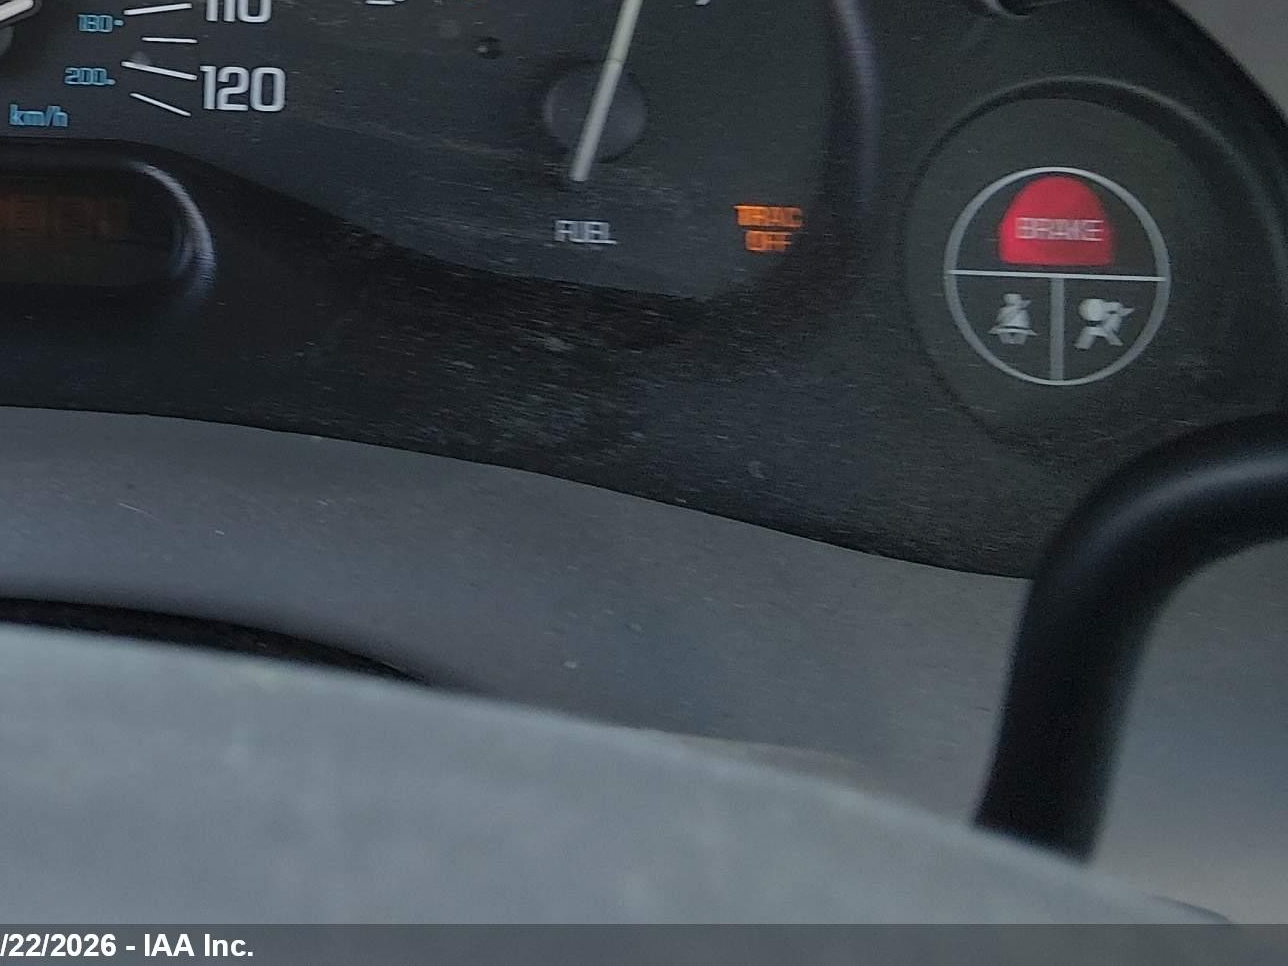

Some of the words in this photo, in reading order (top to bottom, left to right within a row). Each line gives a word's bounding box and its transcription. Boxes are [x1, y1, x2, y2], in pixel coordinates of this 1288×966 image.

[65, 67, 106, 85] 200
[200, 65, 286, 112] 120
[9, 104, 68, 127] km/h
[554, 220, 616, 245] FUEL
[1015, 217, 1103, 242] BRAKE
